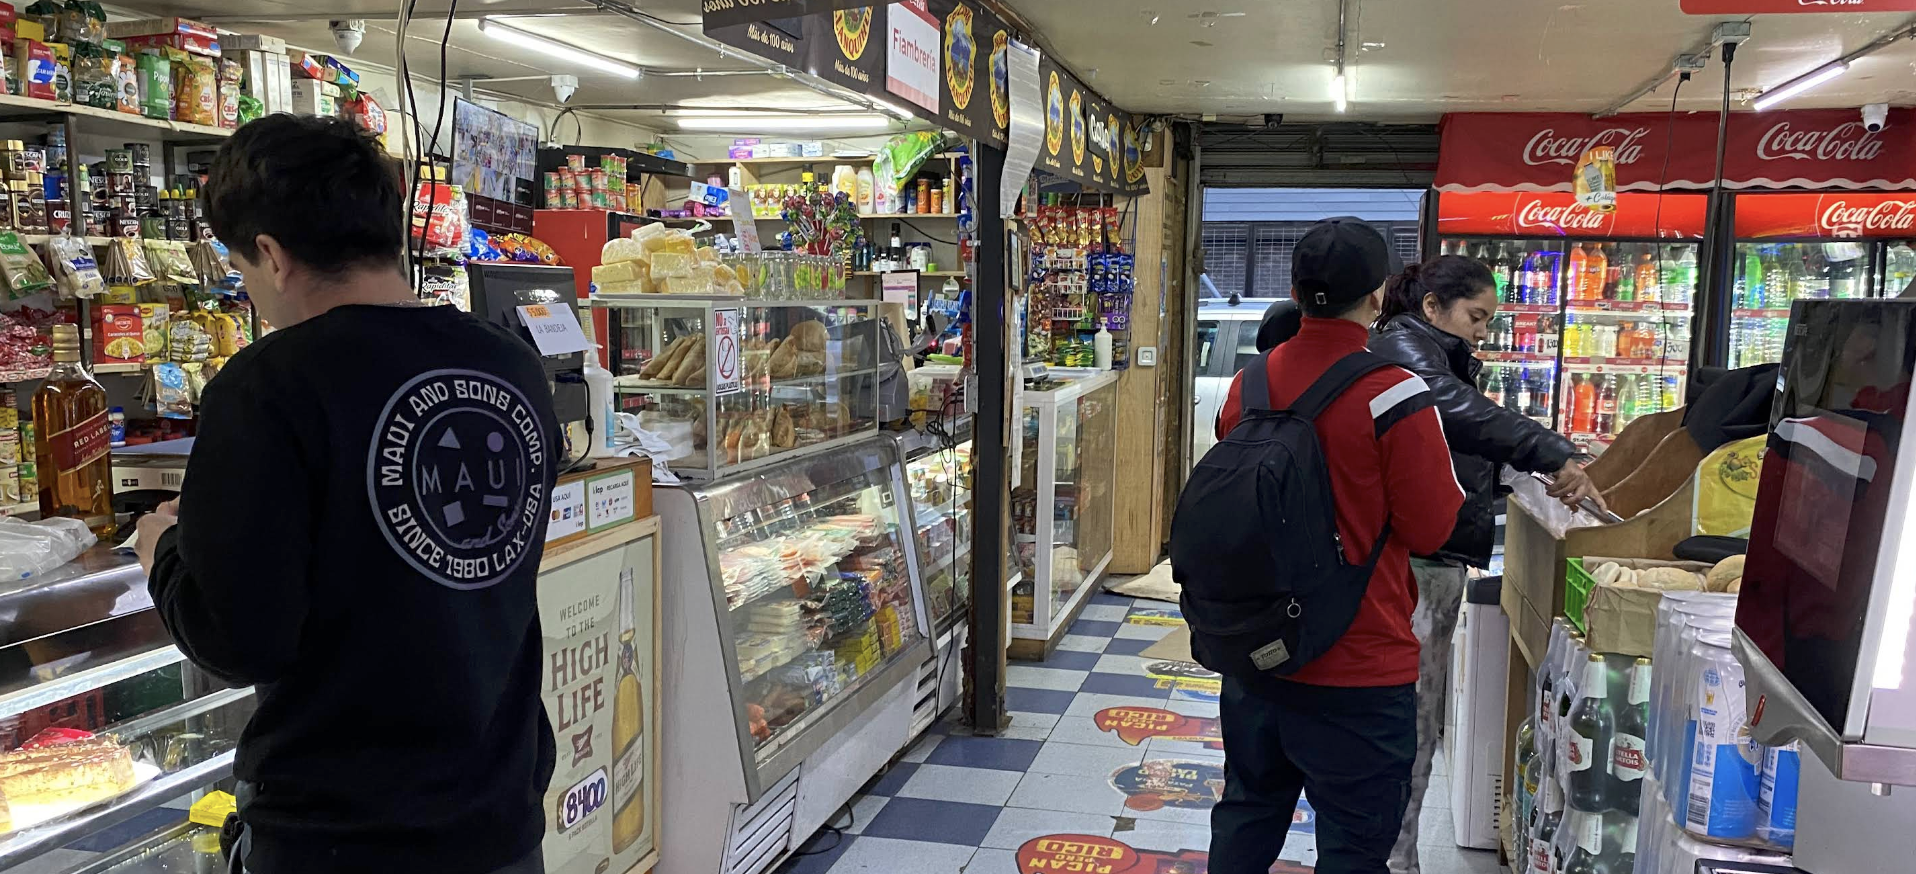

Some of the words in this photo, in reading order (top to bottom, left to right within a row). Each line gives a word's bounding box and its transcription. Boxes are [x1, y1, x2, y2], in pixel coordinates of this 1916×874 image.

[760, 30, 769, 45] de
[769, 34, 780, 49] 100
[893, 27, 936, 73] Fiambrería
[1757, 121, 1892, 160] Coca-Cola
[1518, 200, 1604, 229] Coca-Cola
[1821, 201, 1916, 230] Coca-Cola
[536, 325, 544, 334] LA
[544, 323, 568, 334] BANDEJA
[74, 436, 89, 448] RED
[90, 424, 111, 439] LABEL
[381, 413, 415, 486] MAUI
[409, 381, 449, 417] AND
[454, 379, 511, 411] SONS
[421, 458, 521, 496] MAUI
[387, 503, 444, 568] SINCE
[445, 554, 489, 579] 1980
[492, 482, 542, 571] LAX-USA
[560, 594, 600, 622] WELCOME
[566, 625, 576, 639] TO
[579, 617, 595, 636] THE
[550, 631, 609, 692] HIGH
[557, 676, 604, 733] LIFE
[1115, 711, 1167, 721] RICO
[1104, 720, 1168, 731] PICAN
[615, 772, 631, 795] HIGH
[630, 754, 642, 777] LIFE
[566, 777, 606, 824] 8400
[1045, 841, 1113, 858] RICO
[1029, 857, 1112, 874] PICAN
